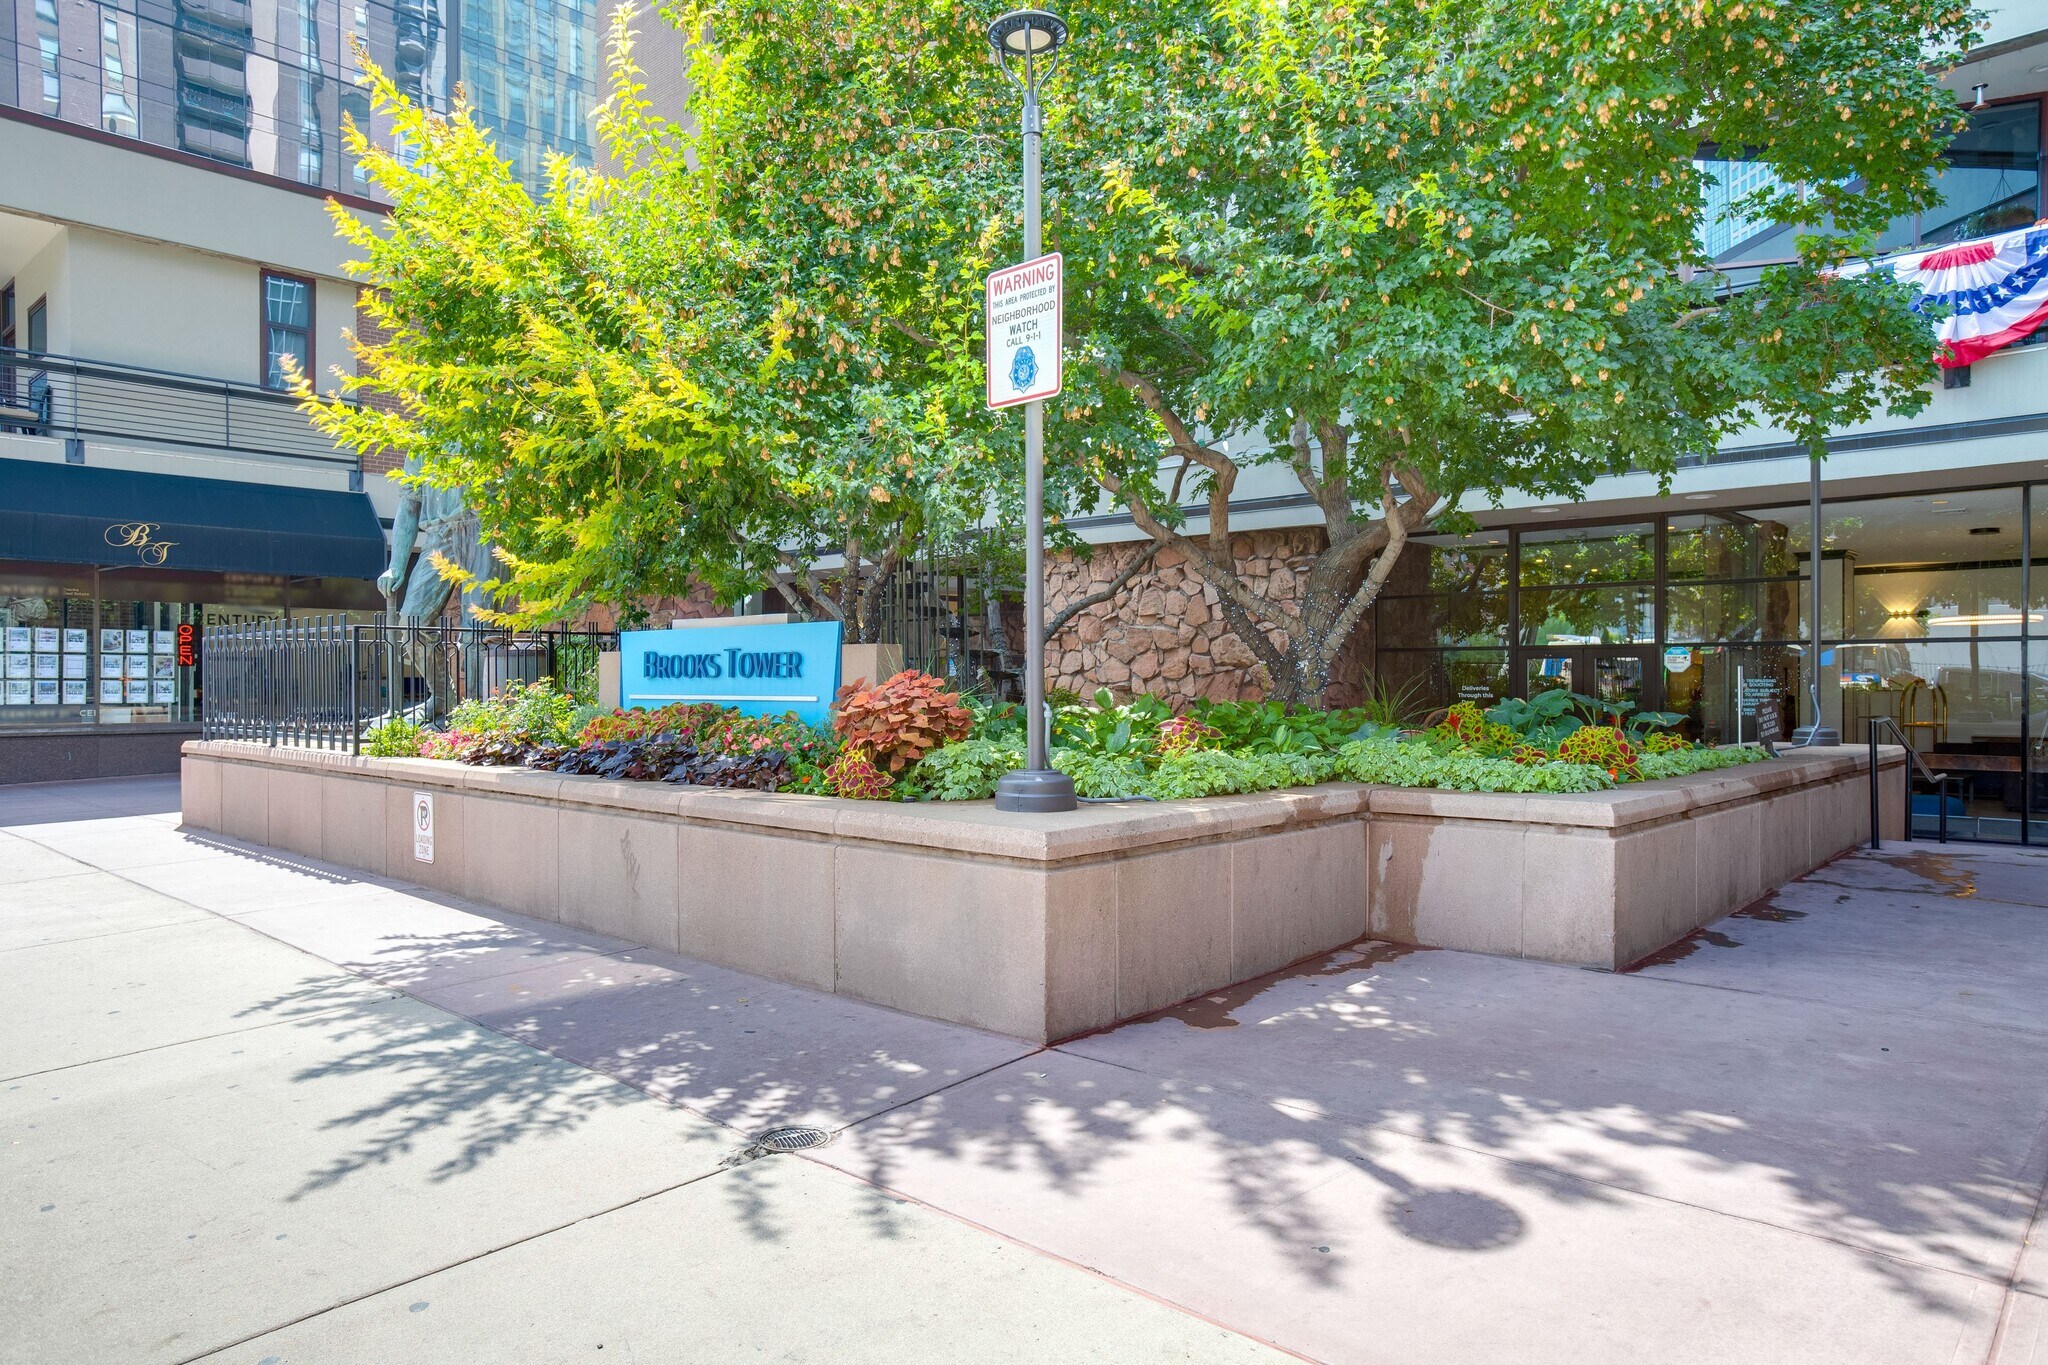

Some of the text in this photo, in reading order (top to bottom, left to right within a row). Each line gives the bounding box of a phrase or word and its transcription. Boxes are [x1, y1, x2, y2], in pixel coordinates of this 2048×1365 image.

[993, 263, 1055, 297] WARNING
[992, 284, 1056, 310] THIS AREA PROTECTED BY
[992, 300, 1056, 326] NEIGHBORHOOD
[1006, 331, 1041, 348] CALL 9-1-1
[1009, 318, 1038, 336] WATCH
[178, 624, 193, 666] OPEN
[723, 648, 803, 679] TOWER
